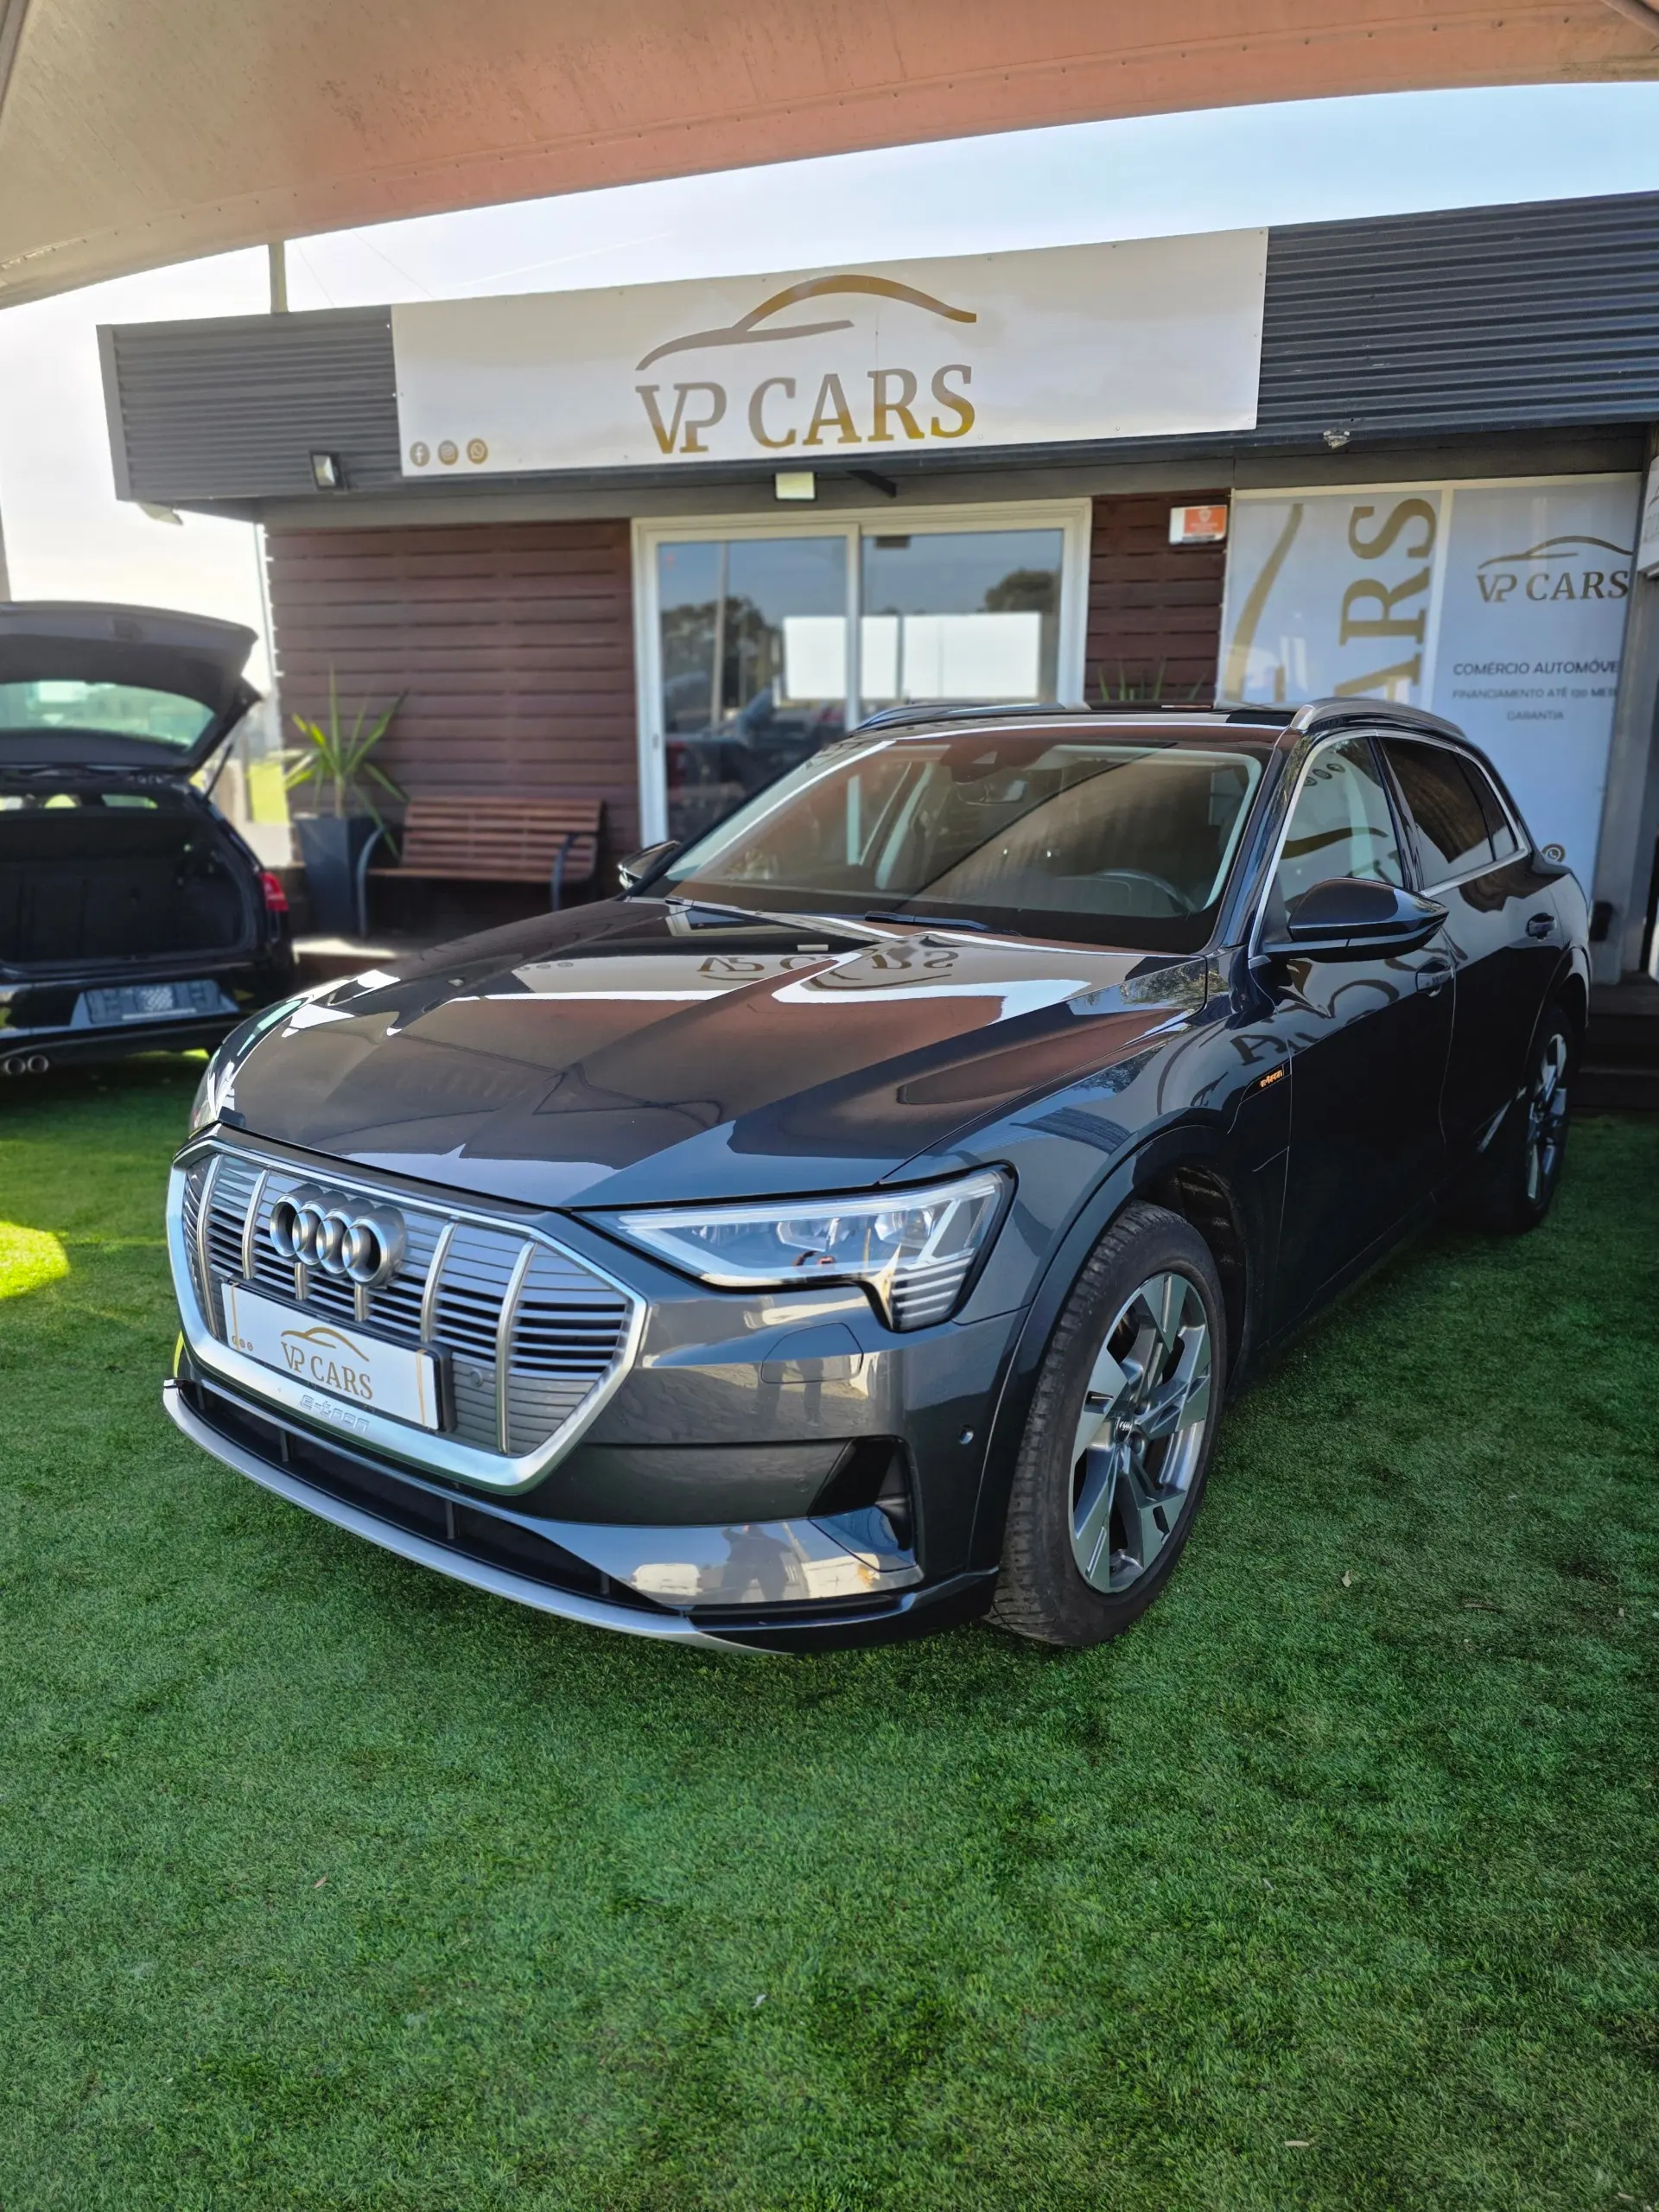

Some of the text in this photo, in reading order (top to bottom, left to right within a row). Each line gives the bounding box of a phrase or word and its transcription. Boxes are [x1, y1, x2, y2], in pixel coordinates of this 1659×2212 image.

[635, 364, 977, 454] VP CARS
[1477, 570, 1629, 603] VP CARS
[1453, 662, 1530, 676] COMÉRCIO
[1506, 710, 1565, 721] GARANTIA
[281, 1341, 373, 1401] VP CARS
[299, 1393, 371, 1434] e-tron
